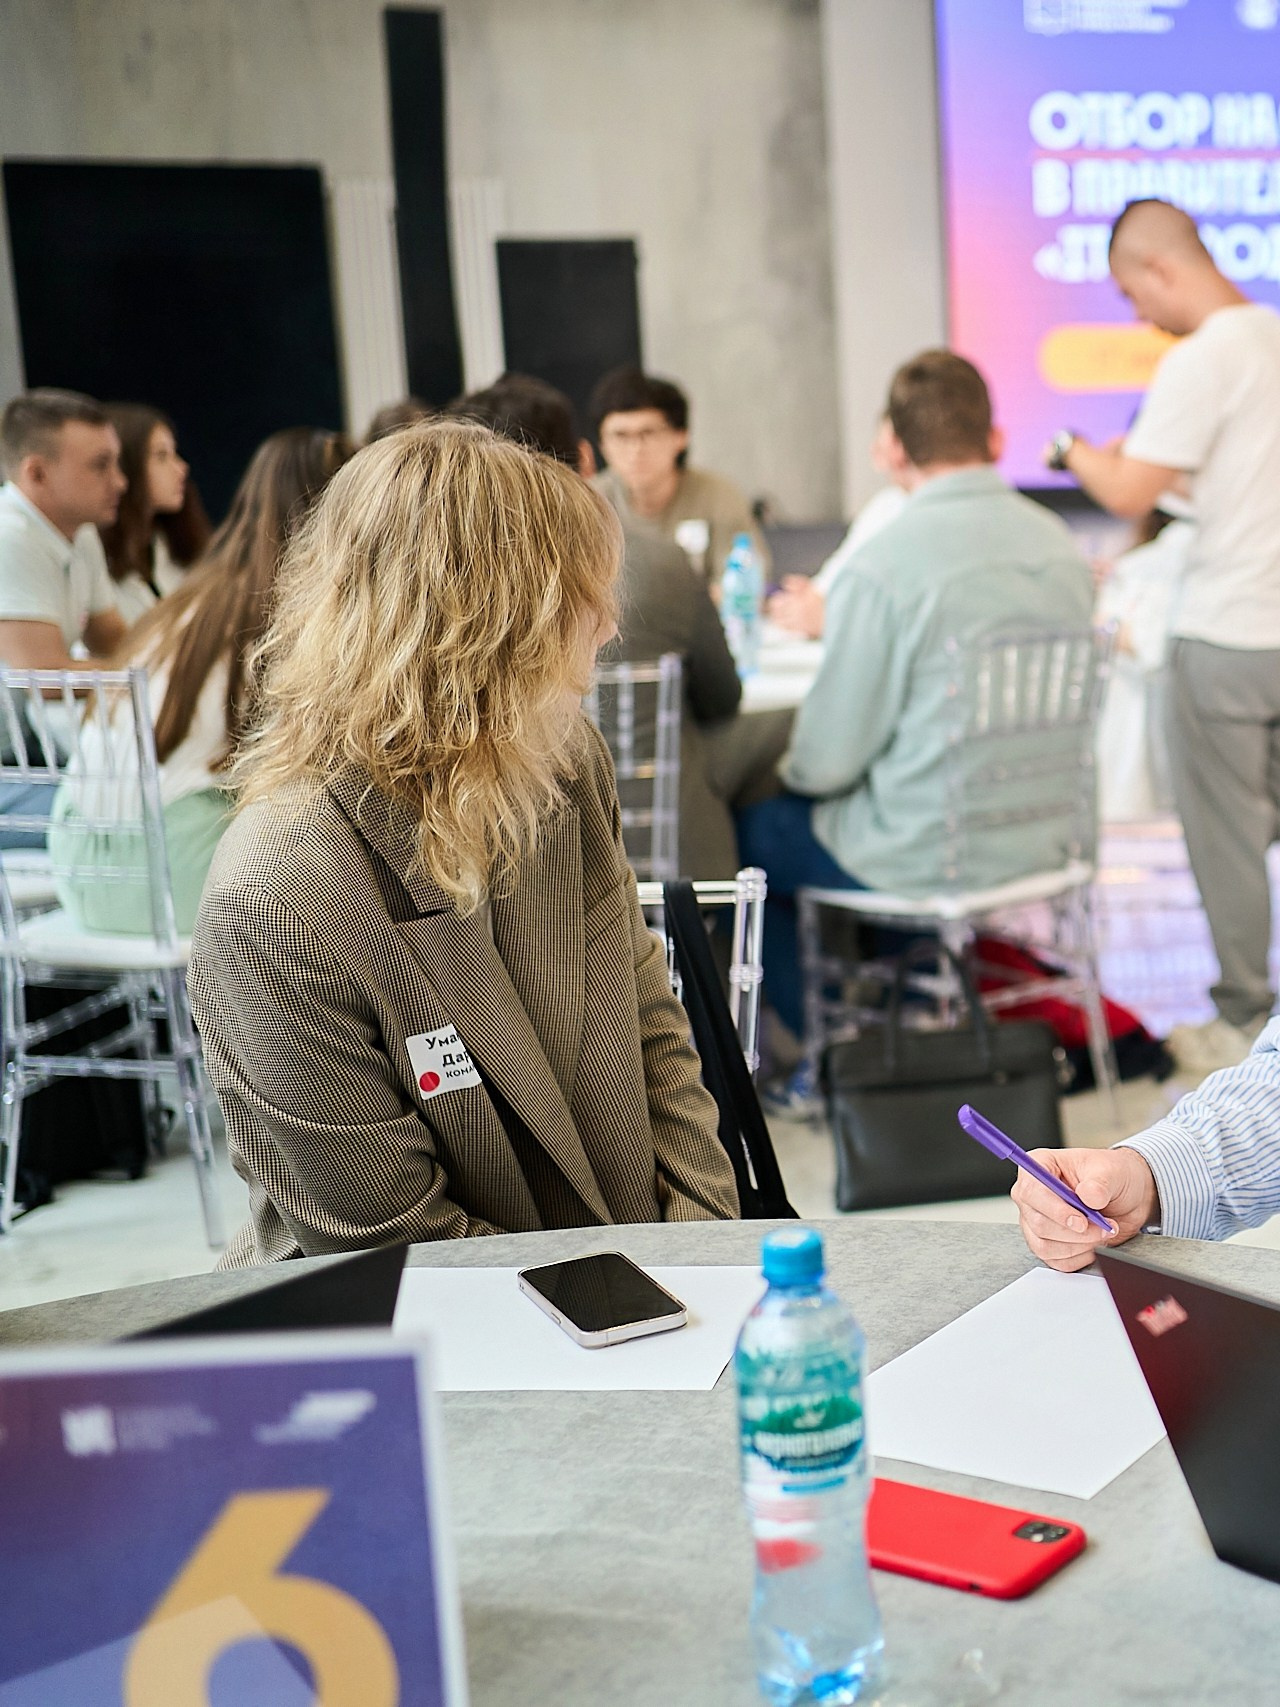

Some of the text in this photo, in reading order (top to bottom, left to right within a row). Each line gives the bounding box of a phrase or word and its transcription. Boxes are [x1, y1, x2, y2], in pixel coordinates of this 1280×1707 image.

[1029, 92, 1210, 150] ОТБОР
[1212, 93, 1279, 148] НА
[1033, 159, 1070, 216] В
[425, 1033, 461, 1050] Ума
[442, 1052, 469, 1067] Дар
[124, 1489, 399, 1707] 6
